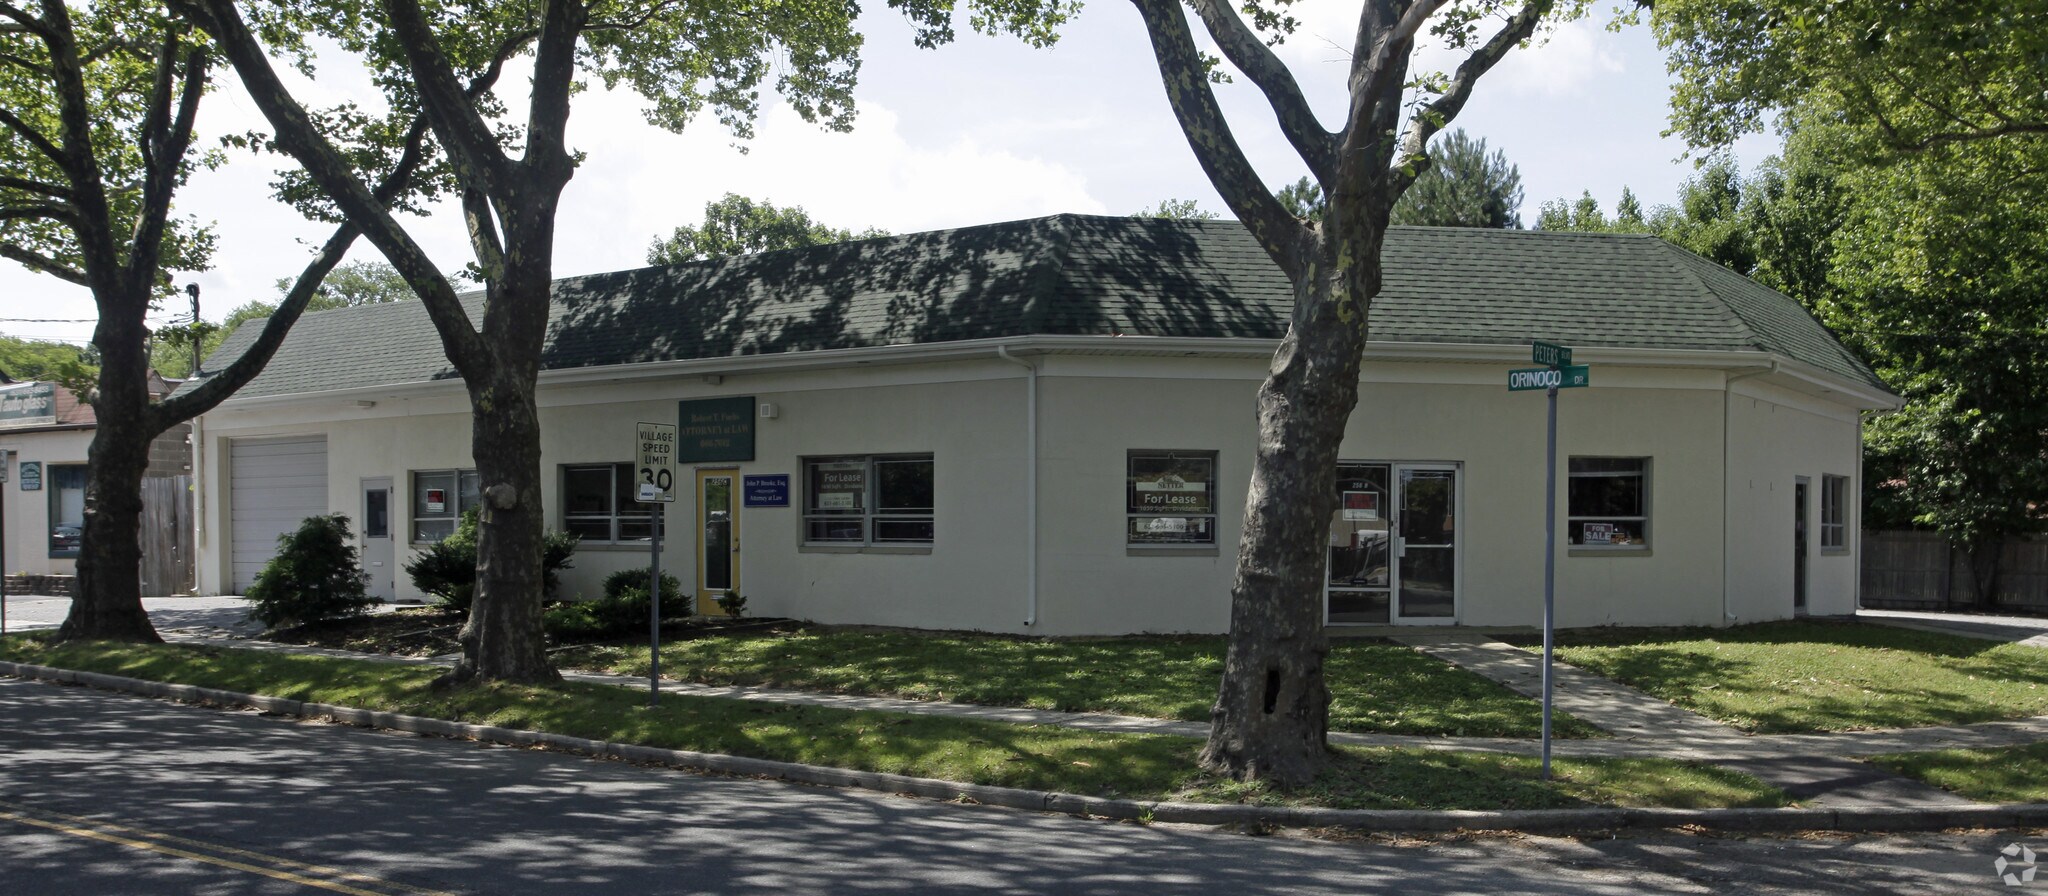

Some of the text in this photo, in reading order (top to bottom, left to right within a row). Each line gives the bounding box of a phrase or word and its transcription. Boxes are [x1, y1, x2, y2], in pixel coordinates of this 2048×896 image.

[1535, 345, 1558, 364] PETERS
[1510, 370, 1584, 388] ORINOCO DR
[22, 395, 47, 414] glass
[680, 425, 722, 436] ATTORNEY
[731, 423, 750, 433] LAW
[640, 431, 673, 442] VILLAGE
[643, 443, 670, 453] SPEED
[645, 455, 668, 465] LIMIT
[640, 468, 673, 492] 30
[824, 473, 861, 482] For Lease
[1144, 493, 1197, 504] For Lease
[1585, 531, 1610, 540] SALE
